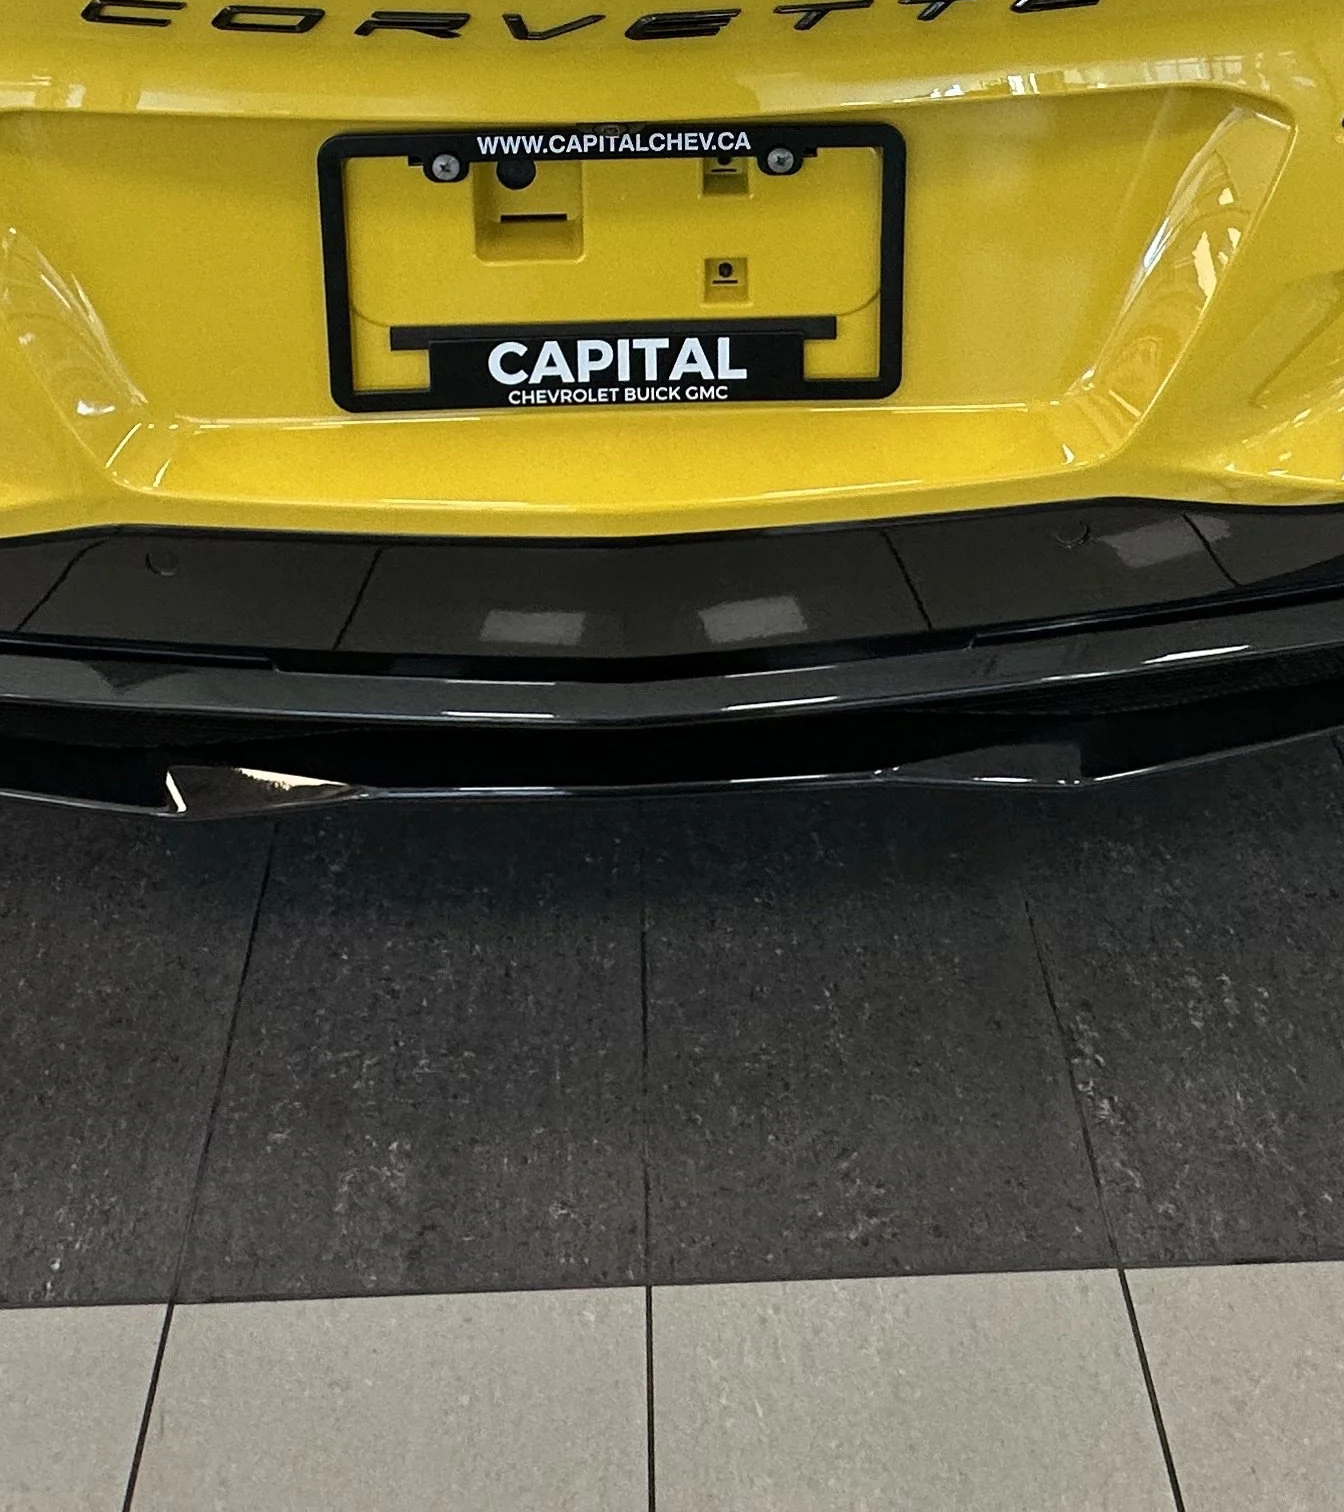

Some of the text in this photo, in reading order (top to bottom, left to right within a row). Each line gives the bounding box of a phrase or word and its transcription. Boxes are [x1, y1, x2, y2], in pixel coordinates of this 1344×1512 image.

[476, 131, 752, 155] WWW.CAPITALCHEV.CA
[487, 336, 748, 385] CAPITAL
[508, 385, 729, 405] CHEVROLET BUICK GMC
